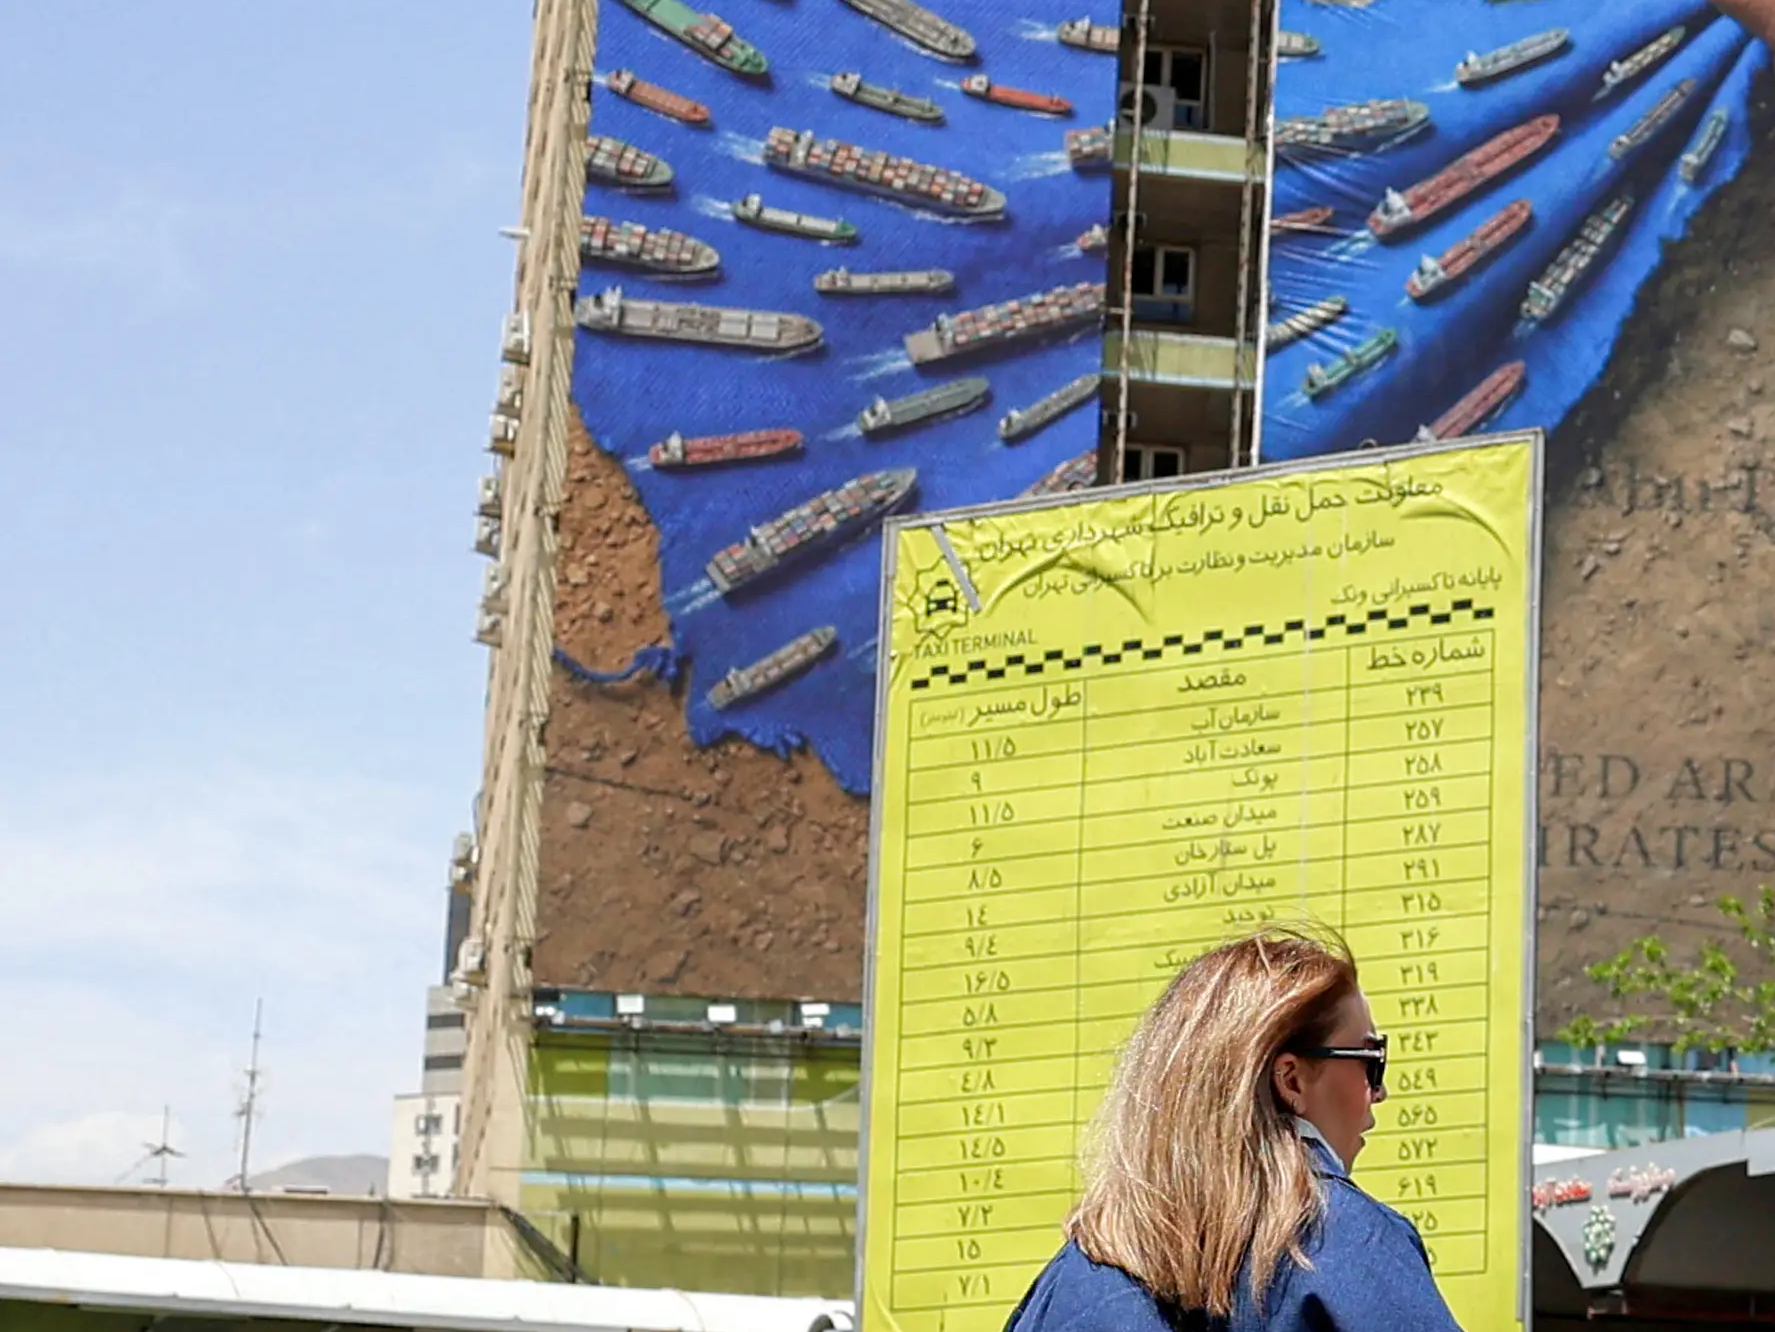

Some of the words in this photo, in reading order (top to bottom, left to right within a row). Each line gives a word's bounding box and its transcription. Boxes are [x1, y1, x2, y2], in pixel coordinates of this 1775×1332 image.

[1295, 487, 1348, 521] حمل
[1355, 475, 1443, 507] معاونت
[1249, 494, 1290, 528] نقل
[1041, 520, 1143, 552] شهرداری
[1327, 530, 1394, 559] سازمان
[1249, 540, 1321, 568] مدیریت
[1331, 585, 1367, 607] ونک
[952, 630, 1038, 655] TERMINAL
[1413, 637, 1486, 670] شماره
[1366, 645, 1406, 671] خط
[1178, 669, 1246, 693] مقصد
[968, 700, 1026, 727] مسیر
[1031, 683, 1081, 718] طول
[1184, 740, 1216, 766] آباد
[1219, 739, 1281, 762] سعادت
[1232, 767, 1279, 792] پونک
[1223, 804, 1277, 829] میدان
[1255, 835, 1277, 860] پل
[1163, 870, 1216, 903] آزادی
[1223, 872, 1276, 897] میدان
